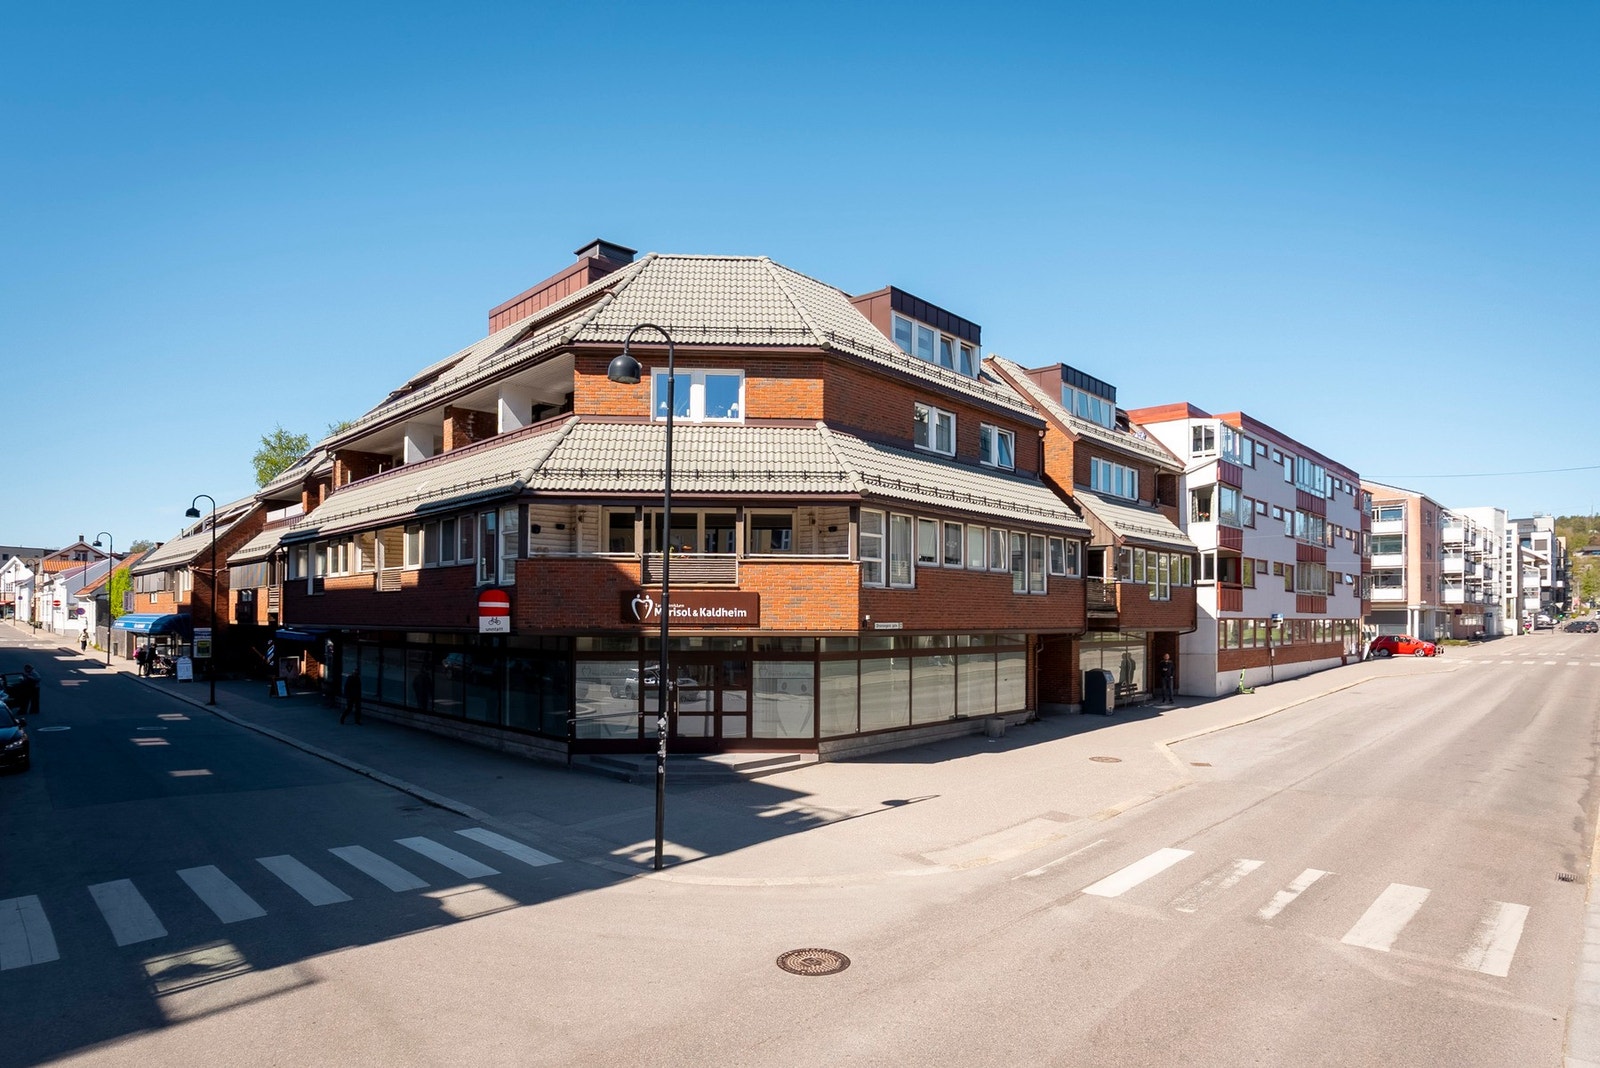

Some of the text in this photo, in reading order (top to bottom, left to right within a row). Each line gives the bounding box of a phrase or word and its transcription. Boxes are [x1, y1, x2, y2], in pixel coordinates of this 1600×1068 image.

[654, 607, 747, 617] Mrisol & Kaldheim
